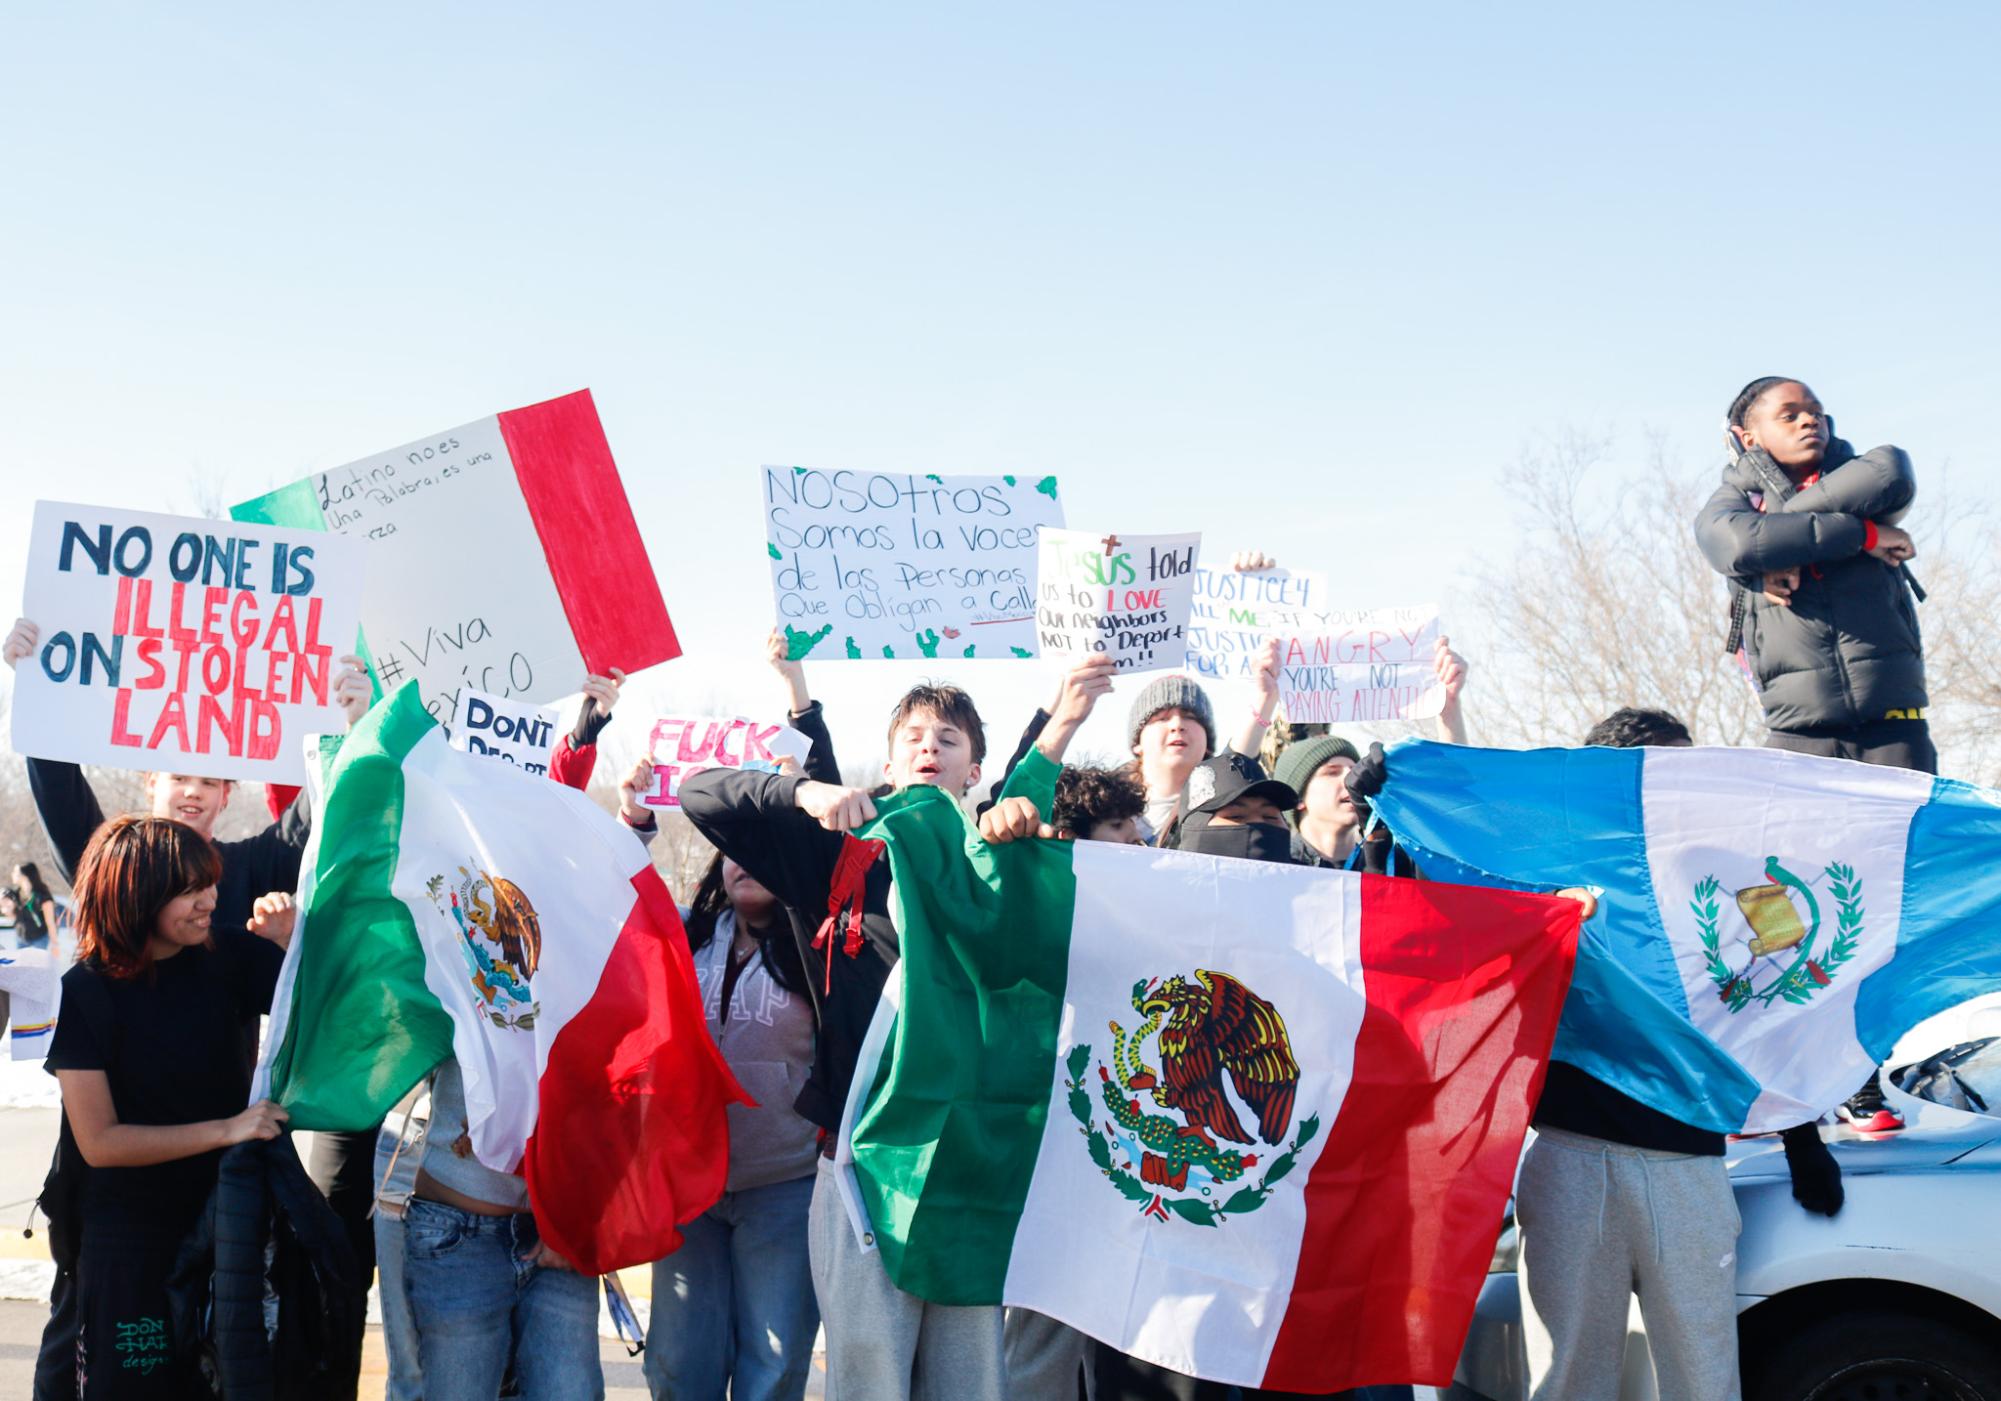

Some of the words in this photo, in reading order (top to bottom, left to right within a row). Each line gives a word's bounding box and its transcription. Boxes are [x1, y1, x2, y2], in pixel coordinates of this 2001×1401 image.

[442, 464, 460, 478] es
[467, 452, 492, 466] una
[319, 464, 395, 510] Latino
[771, 507, 894, 550] Somos
[912, 517, 944, 550] la
[58, 521, 152, 578] NO
[169, 532, 260, 591] ONE
[271, 542, 315, 596] IS
[777, 552, 819, 591] de
[834, 555, 879, 591] las
[895, 562, 1027, 591] Personas
[113, 576, 333, 656] ILLEGAL
[779, 592, 829, 618] Que
[961, 595, 976, 609] a
[1067, 583, 1094, 608] to
[1107, 588, 1172, 612] LOVE
[378, 617, 492, 686] #Viva
[1085, 638, 1107, 652] to
[1185, 650, 1229, 676] FOR
[1286, 624, 1424, 666] ANGRY
[40, 630, 124, 687] ON
[135, 638, 331, 707] STOLEN
[1285, 665, 1339, 692] YOU'RE
[1370, 663, 1403, 689] NOT
[110, 687, 282, 761] LAND
[1285, 688, 1343, 722] PAYING
[1352, 686, 1425, 722] ATTENTI
[649, 717, 781, 766] FUCK
[696, 964, 790, 1027] AP
